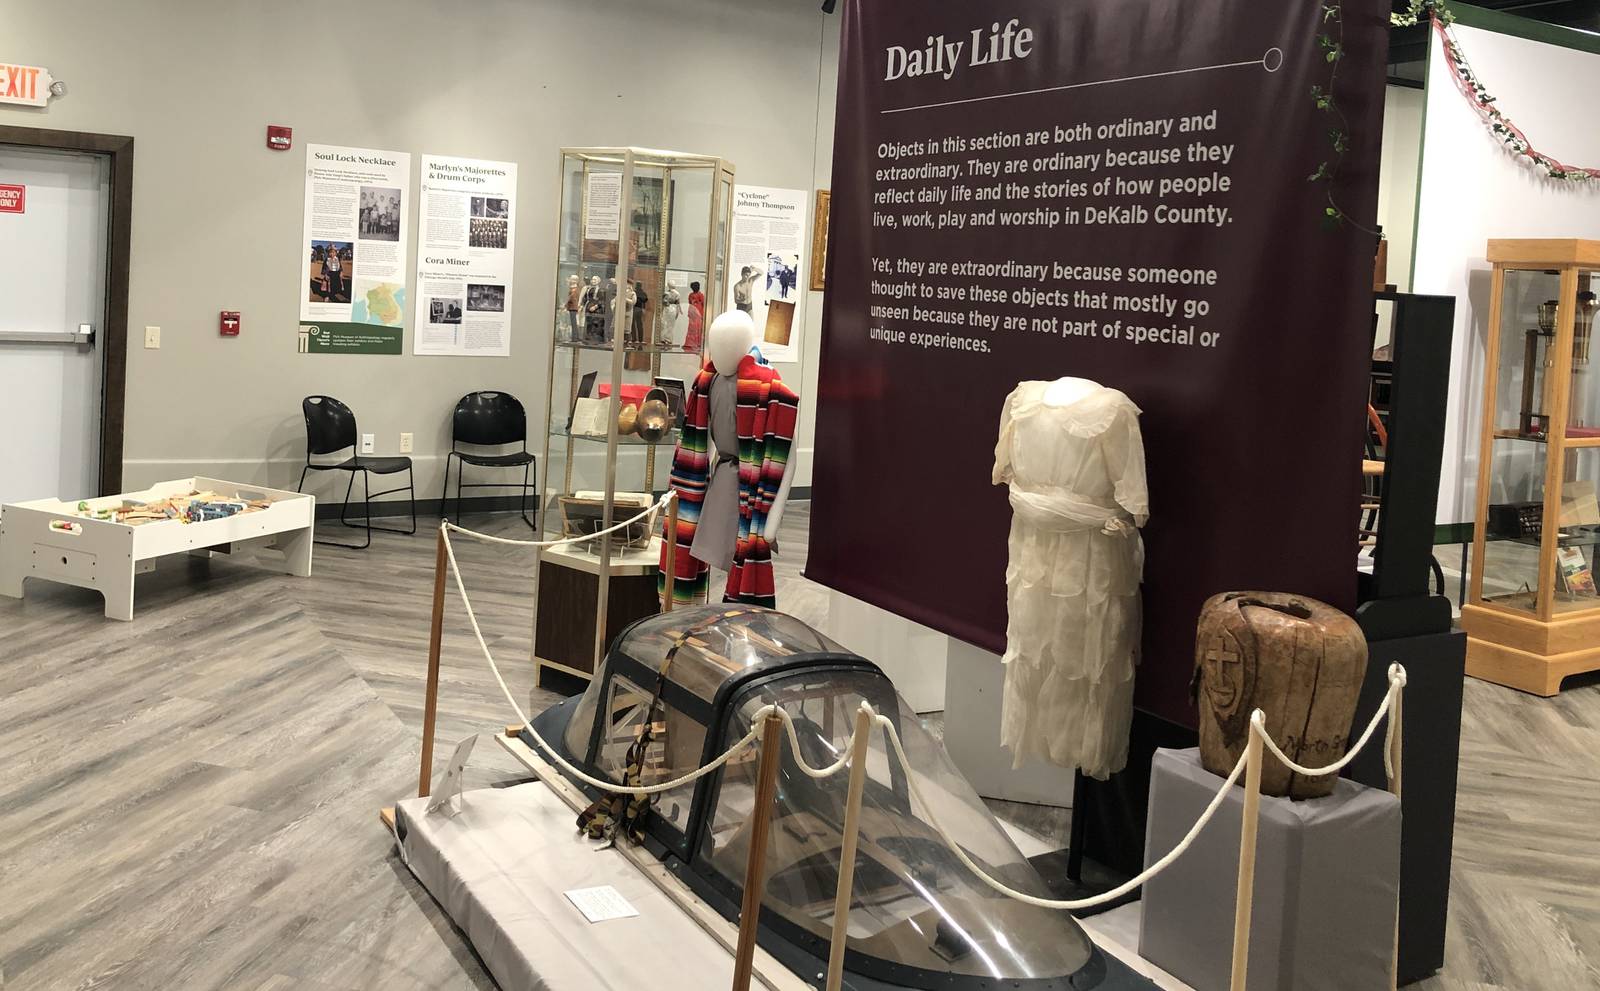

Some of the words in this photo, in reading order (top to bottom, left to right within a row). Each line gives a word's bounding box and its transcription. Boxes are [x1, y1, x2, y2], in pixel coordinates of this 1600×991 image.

[885, 35, 963, 80] Daily
[969, 19, 1033, 66] Life
[877, 141, 924, 161] Objects
[927, 138, 939, 155] in
[942, 135, 966, 154] this
[969, 131, 1021, 151] section
[1024, 130, 1050, 146] are
[1054, 122, 1092, 144] both
[1097, 117, 1174, 140] ordinary
[1179, 109, 1217, 133] and
[314, 152, 334, 161] Soul
[336, 154, 356, 163] Lock
[358, 156, 397, 167] Necklace
[429, 162, 463, 173] Marlyn's
[464, 166, 506, 176] Majorettes
[875, 162, 963, 182] extraordinary.
[967, 158, 1001, 178] They
[1004, 159, 1028, 174] are
[1032, 152, 1101, 172] ordinary
[1105, 148, 1181, 167] because
[1187, 141, 1235, 165] they
[436, 173, 461, 181] Drum
[462, 175, 486, 184] Corps
[874, 188, 915, 204] reflect
[917, 186, 948, 205] daily
[951, 184, 972, 202] life
[975, 182, 1002, 201] and
[1005, 182, 1030, 200] the
[1033, 179, 1088, 199] stories
[1092, 176, 1111, 196] of
[1115, 176, 1154, 195] how
[1159, 171, 1231, 198] people
[1, 199, 17, 207] ONLY
[737, 199, 760, 208] Johnny
[761, 202, 795, 211] Thompson
[873, 211, 898, 230] live,
[901, 210, 935, 230] work,
[938, 209, 967, 230] play
[969, 208, 996, 226] and
[999, 207, 1060, 229] worship
[1064, 206, 1080, 225] in
[1084, 204, 1149, 225] DeKalb
[1154, 204, 1233, 227] County.
[425, 256, 444, 265] Cora
[445, 257, 470, 266] Miner
[871, 257, 893, 275] Yet,
[896, 257, 926, 277] they
[928, 262, 948, 275] are
[951, 260, 1049, 282] extraordinary
[1053, 261, 1122, 282] because
[1127, 267, 1218, 286] someone
[871, 279, 917, 299] thought
[920, 283, 934, 298] to
[936, 286, 966, 301] save
[969, 284, 1008, 303] these
[1012, 287, 1069, 308] objects
[1073, 289, 1108, 310] that
[1113, 293, 1178, 318] mostly
[1183, 299, 1210, 319] go
[870, 305, 909, 320] unseen
[912, 306, 965, 325] because
[968, 309, 1000, 331] they
[1003, 316, 1028, 331] are
[1031, 316, 1058, 334] not
[1062, 319, 1098, 338] part
[1102, 320, 1122, 339] of
[1125, 324, 1194, 345] special
[1199, 331, 1220, 347] or
[870, 325, 906, 345] unique
[909, 327, 993, 353] experiences.
